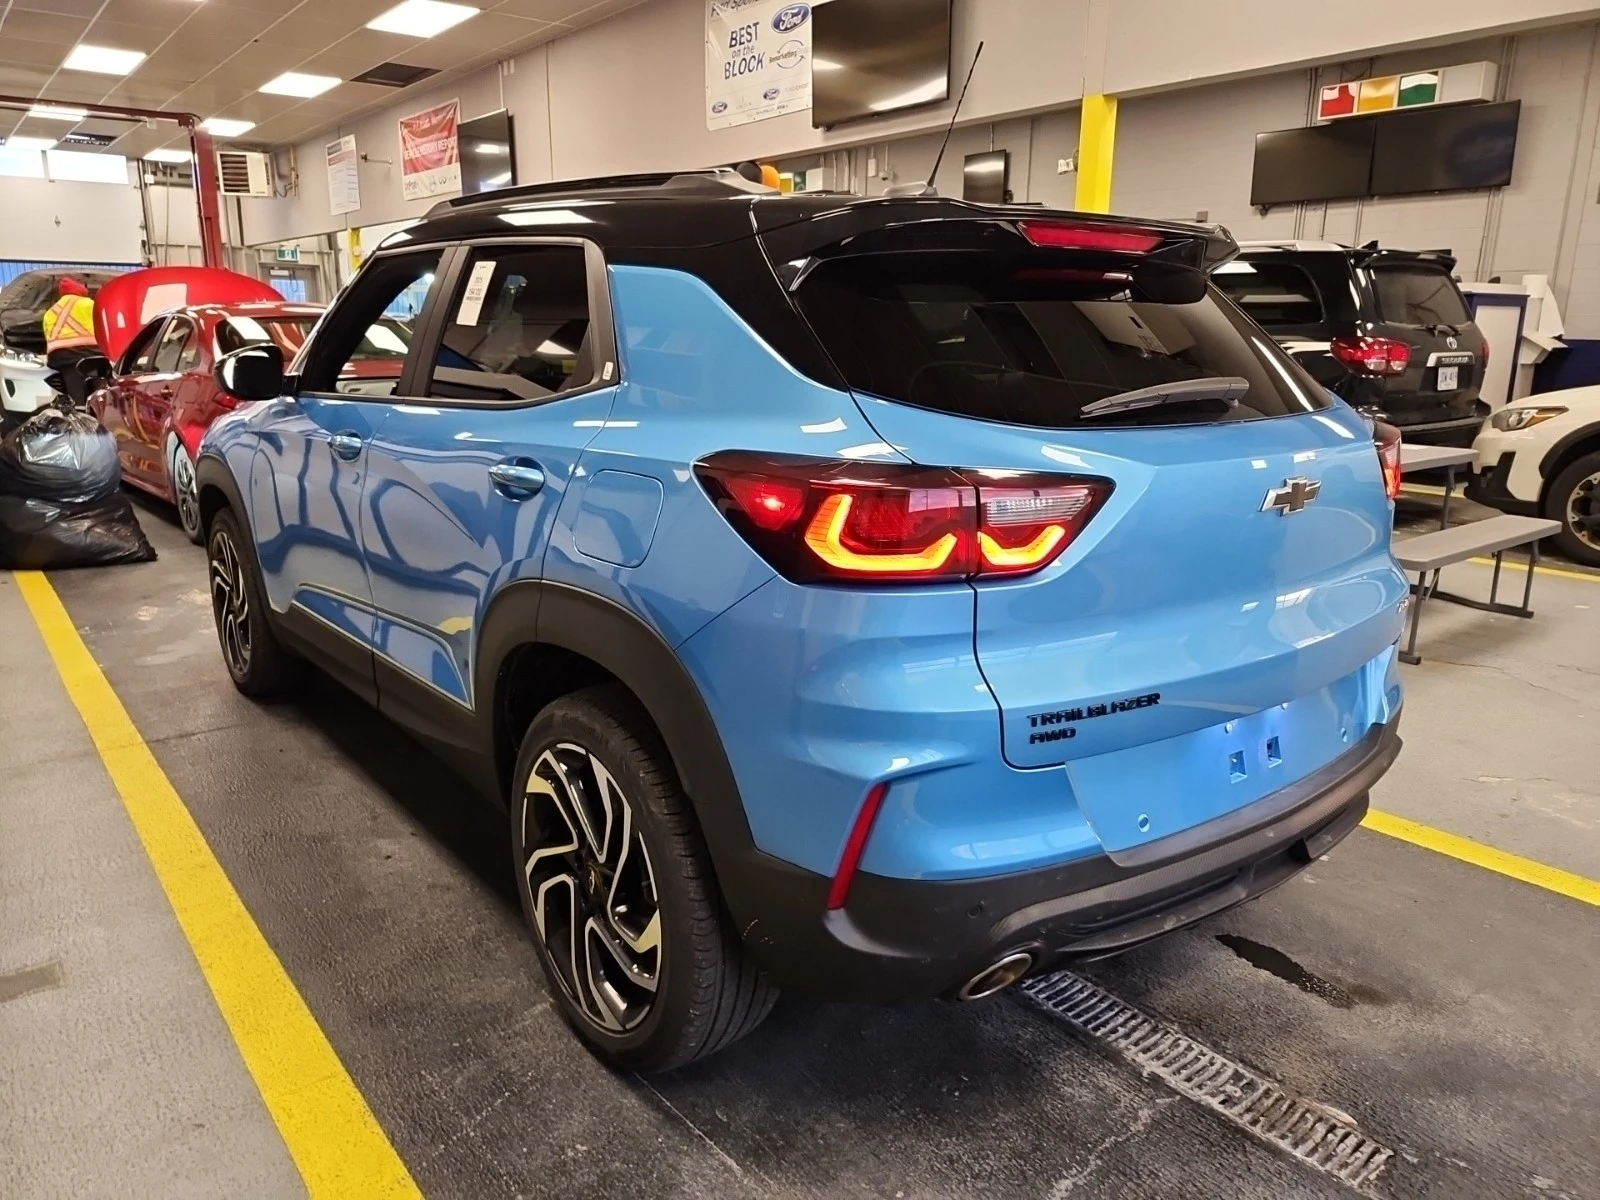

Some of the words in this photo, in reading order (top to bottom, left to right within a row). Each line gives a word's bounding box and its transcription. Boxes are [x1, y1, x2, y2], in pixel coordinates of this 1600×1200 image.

[778, 8, 807, 31] Ford
[729, 21, 760, 48] BEST
[731, 48, 741, 59] on
[742, 44, 755, 56] the
[724, 52, 766, 80] BLOCK
[1026, 692, 1162, 728] TRAILBLAZER
[1029, 727, 1077, 744] AWD
